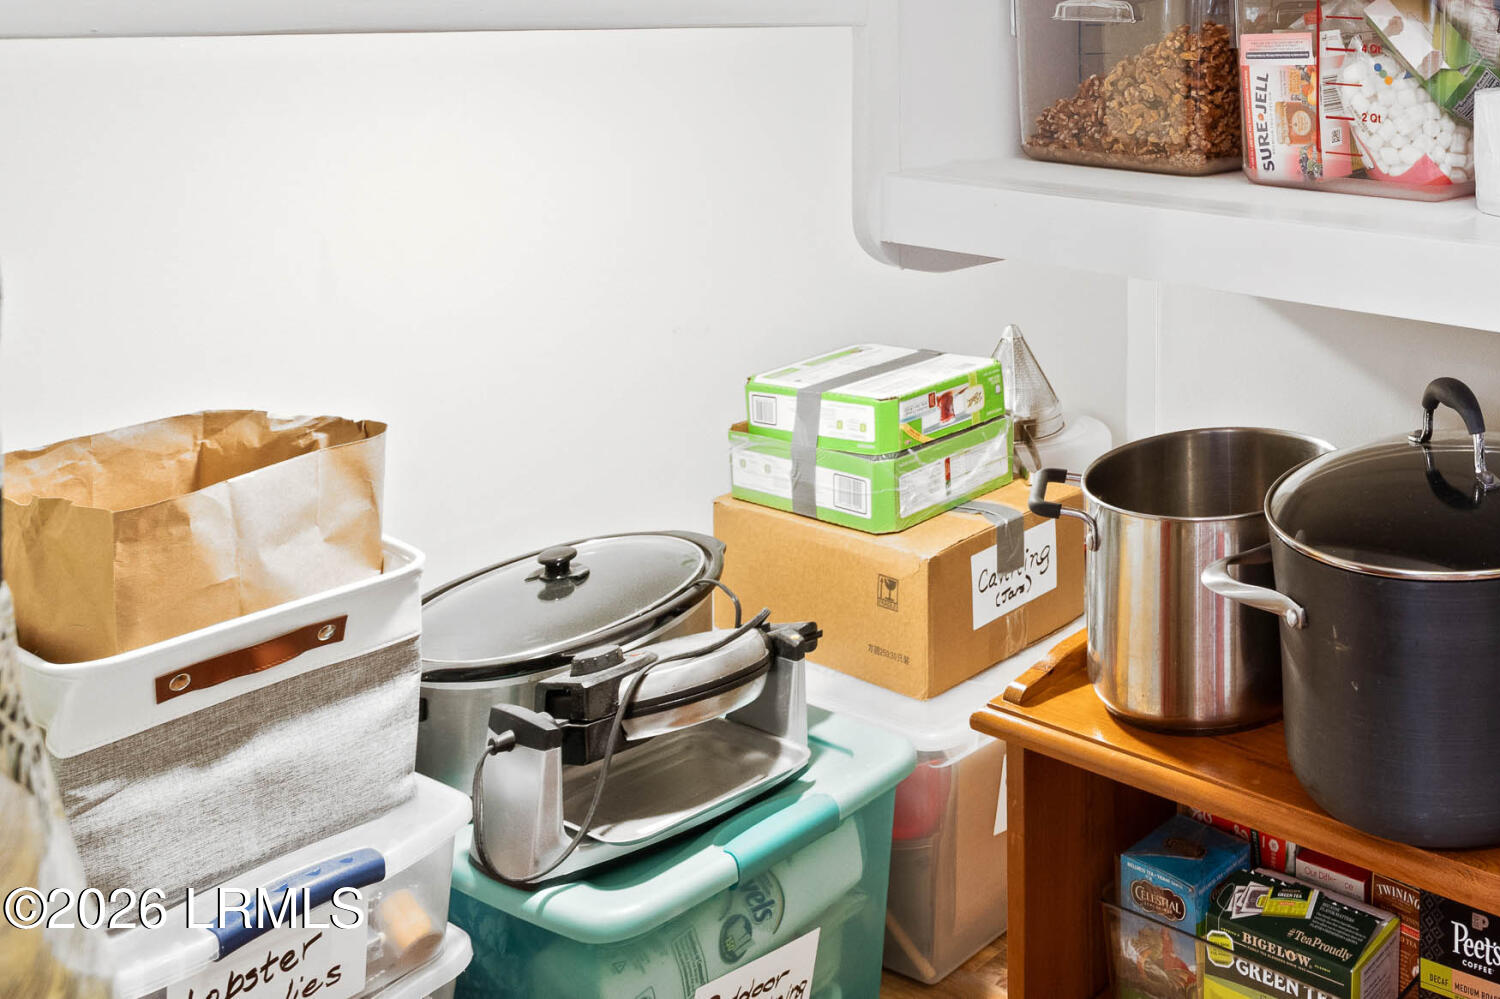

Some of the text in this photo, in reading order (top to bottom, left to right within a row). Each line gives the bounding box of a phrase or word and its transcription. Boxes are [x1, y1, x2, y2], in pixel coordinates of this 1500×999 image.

[1369, 45, 1382, 54] Qt
[1361, 113, 1382, 124] 2 Qt
[996, 574, 1032, 607] (Jars)
[1134, 886, 1182, 915] CELESTIAL
[1242, 931, 1311, 967] BIGELOW
[1286, 928, 1353, 961] #TeaProudly
[1235, 960, 1299, 998] GREEN
[1462, 959, 1493, 975] COFFEE
[1429, 973, 1480, 997] DECAF MEDIUM
